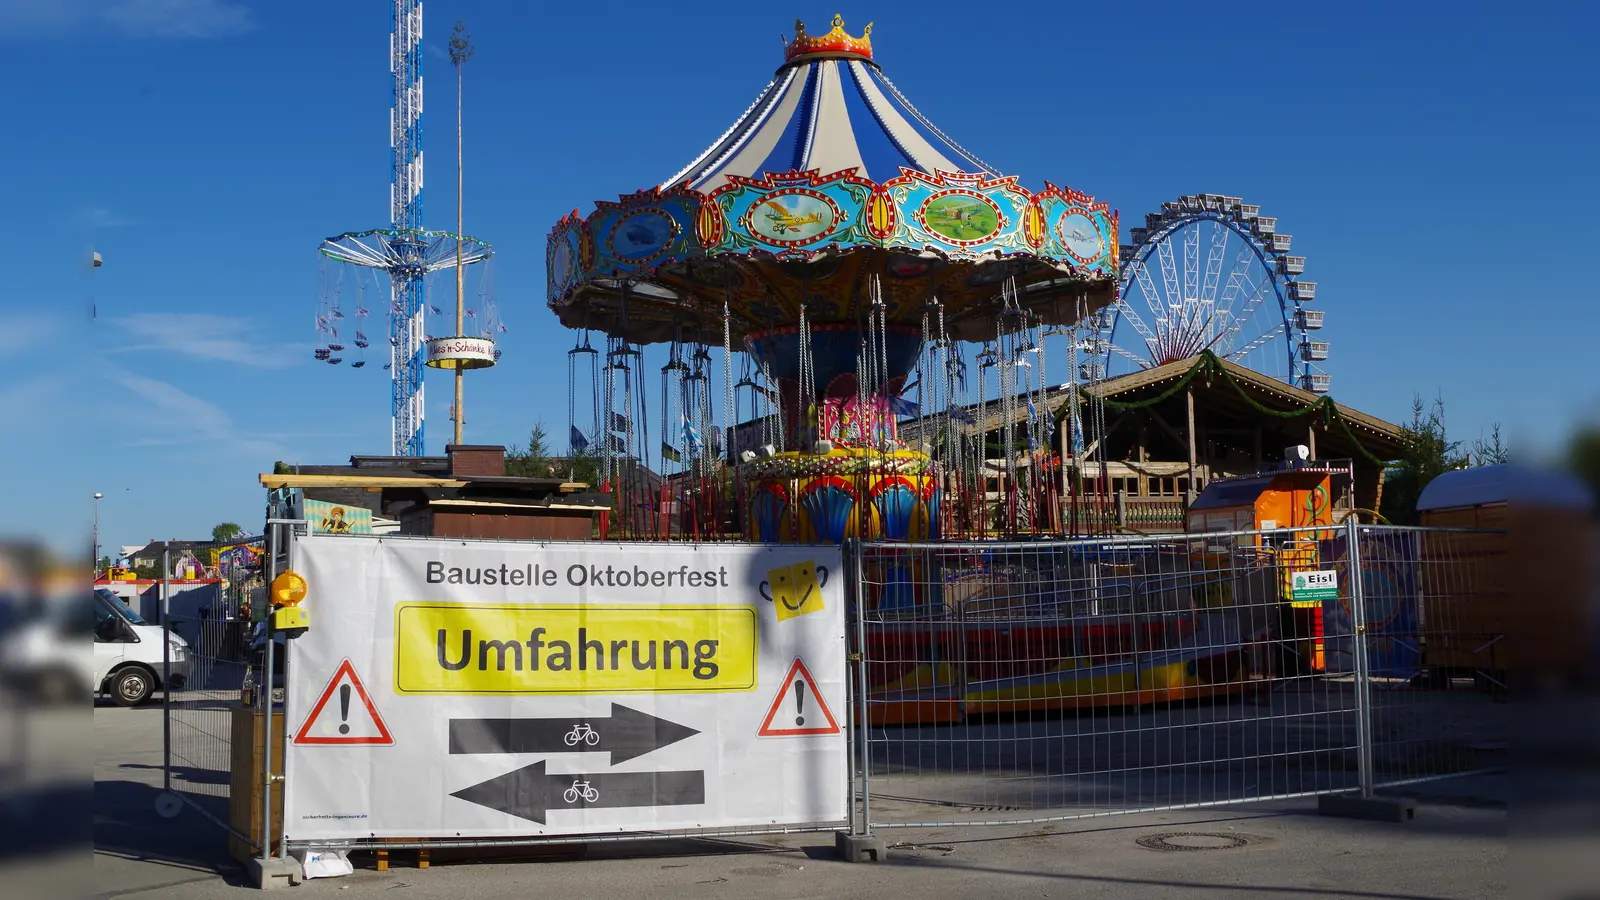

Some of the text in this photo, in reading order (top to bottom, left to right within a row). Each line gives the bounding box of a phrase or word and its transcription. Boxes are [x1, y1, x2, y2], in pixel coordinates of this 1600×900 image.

[426, 561, 729, 588] Baustelle Oktoberfest
[1308, 574, 1332, 583] Eisl
[437, 627, 720, 680] Umfahrung
